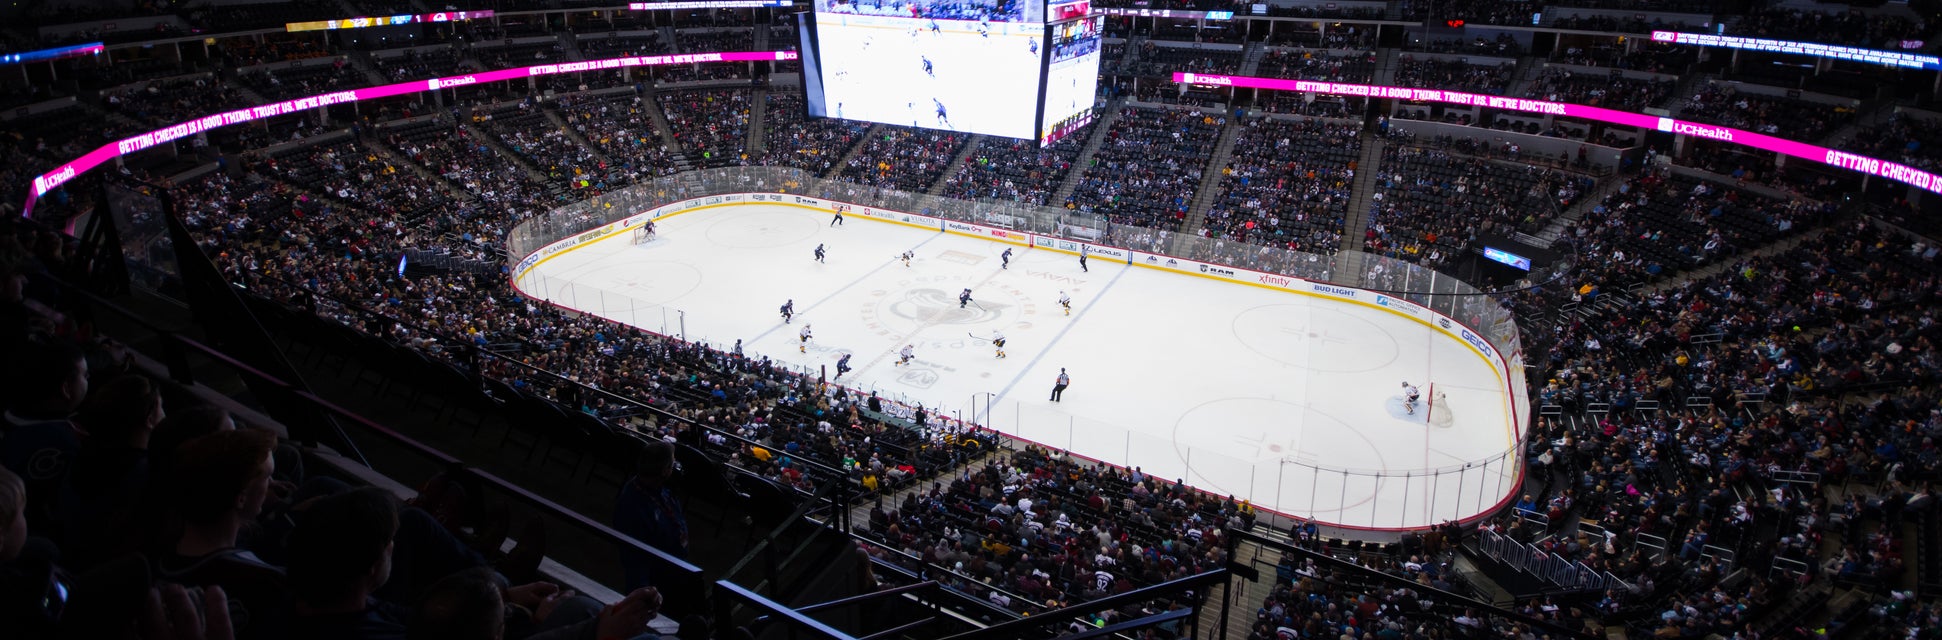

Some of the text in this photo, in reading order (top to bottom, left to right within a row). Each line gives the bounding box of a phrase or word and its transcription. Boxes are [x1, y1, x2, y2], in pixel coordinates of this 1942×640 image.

[529, 65, 558, 75] GETTING
[558, 62, 588, 72] CHECKED
[588, 61, 596, 69] IS
[602, 59, 620, 68] GOOD
[641, 56, 662, 64] TRUST
[440, 76, 476, 87] UCHealth
[1195, 76, 1232, 85] UCHealth
[1296, 81, 1566, 115] GETTING CHECKED IS A GOOD THING. TRUST US. WE'RE DOCTORS.
[118, 136, 154, 154] GETTING
[154, 124, 188, 144] CHECKED
[188, 122, 197, 134] IS
[202, 114, 222, 129] GOOD
[223, 109, 254, 124] THING.
[254, 104, 281, 118] TRUST
[281, 102, 295, 113] US.
[294, 96, 318, 111] WE'RE
[318, 90, 358, 106] DOCTORS.
[1674, 123, 1733, 140] UCHealth
[44, 165, 75, 189] UCHealth
[1826, 150, 1879, 174] GETTING
[1881, 162, 1930, 189] CHECKED
[549, 240, 576, 254] CAMBRIA
[1092, 248, 1122, 257] LEXUS
[518, 254, 538, 273] GEICO
[1258, 275, 1290, 287] xfinity
[1332, 287, 1355, 296] LIGHT
[1462, 329, 1492, 357] GEICO
[1096, 579, 1108, 592] 92
